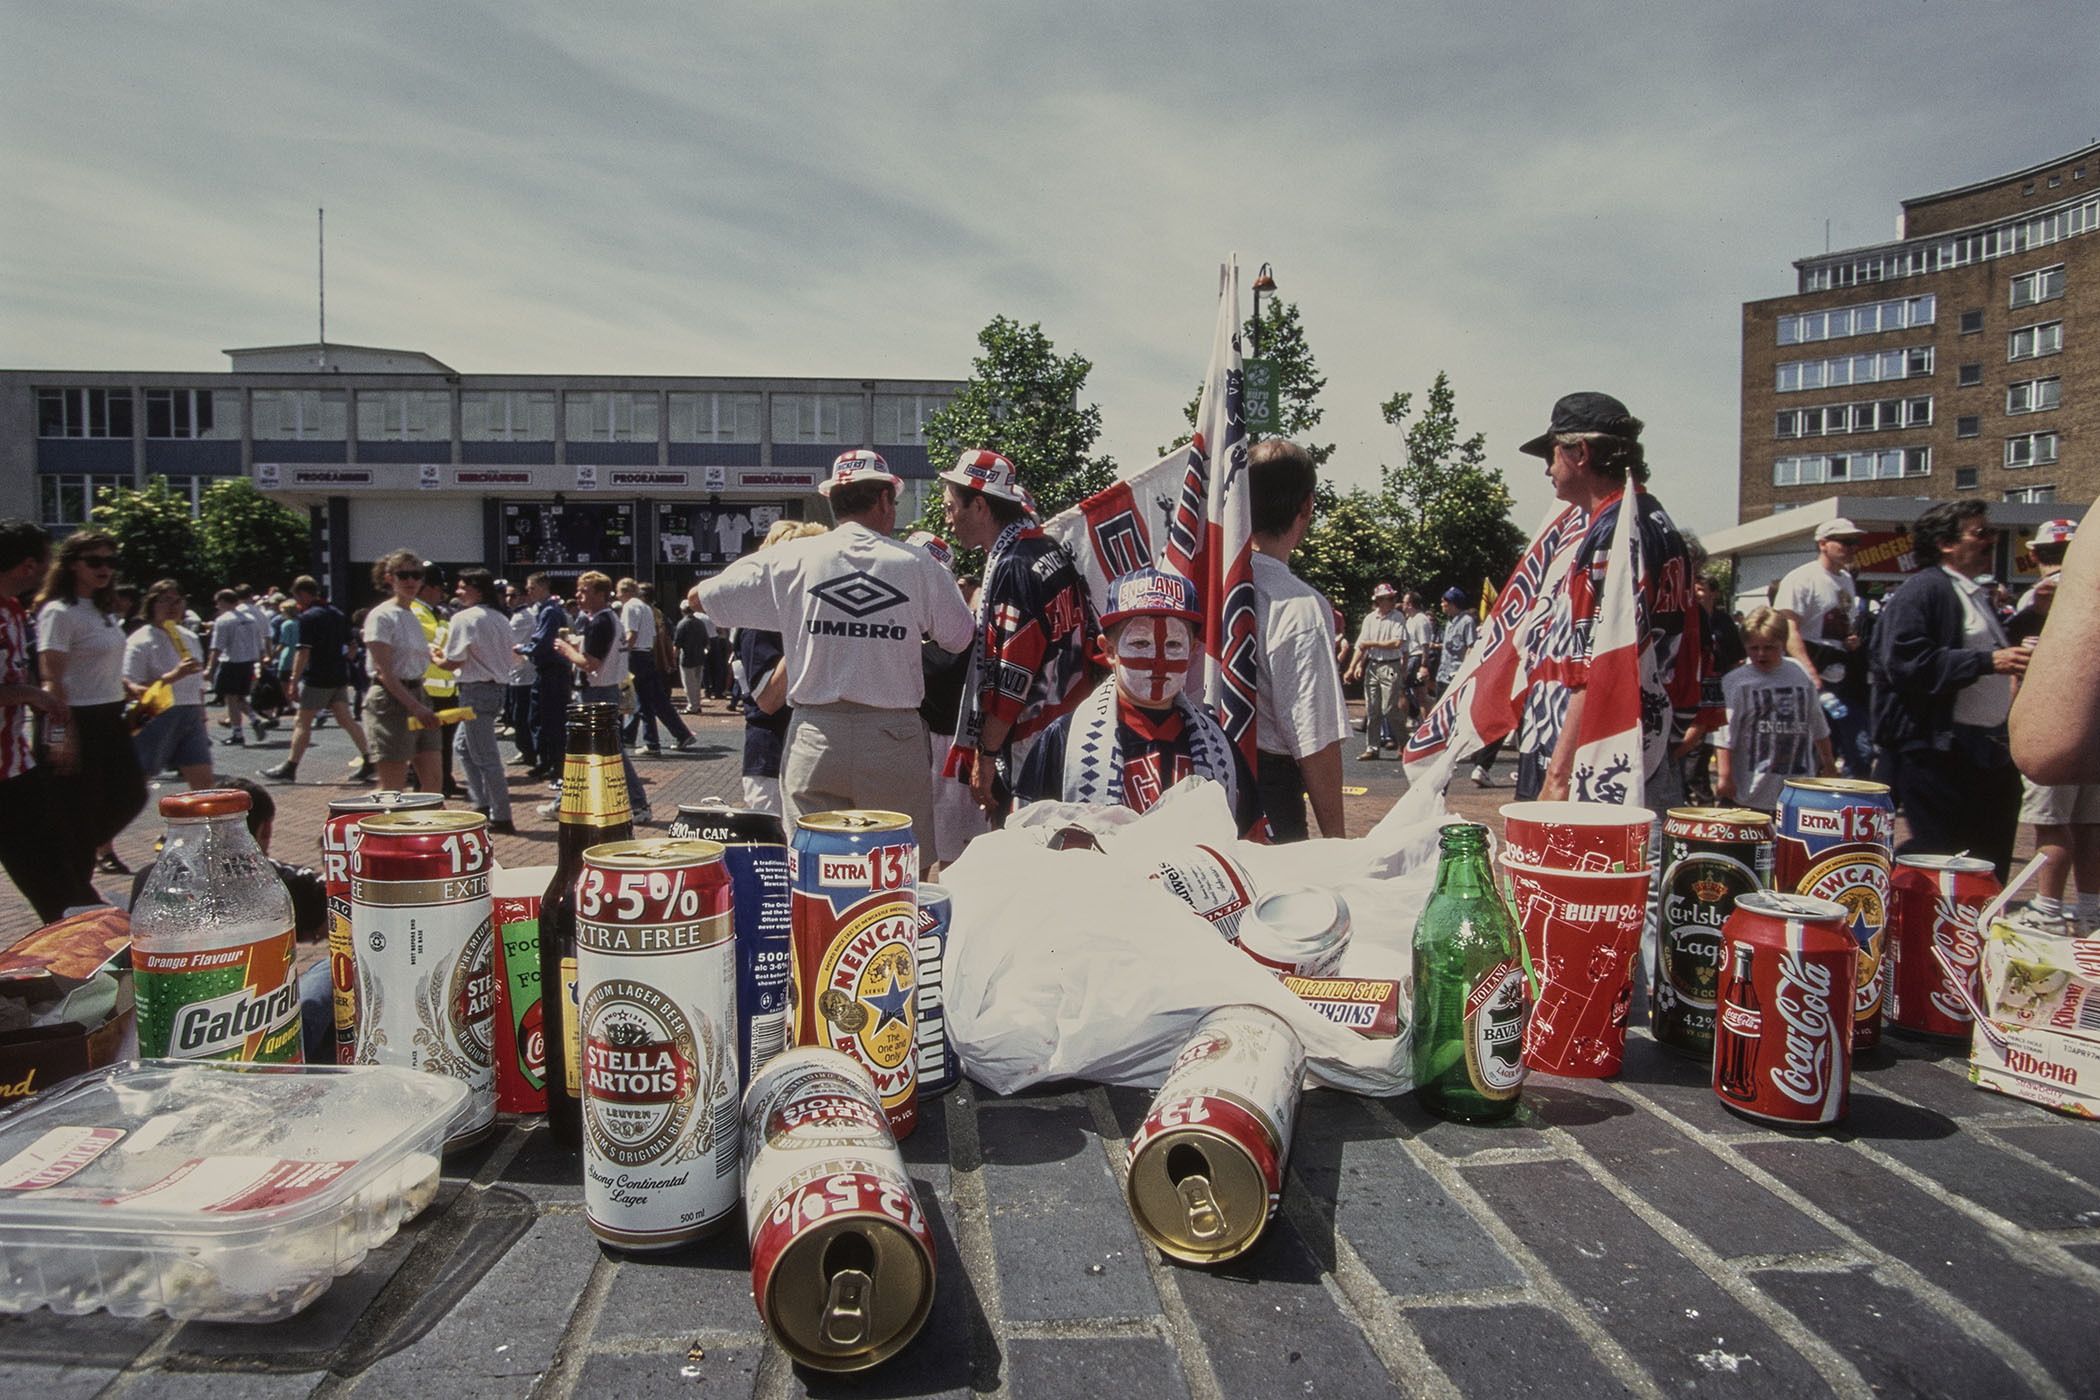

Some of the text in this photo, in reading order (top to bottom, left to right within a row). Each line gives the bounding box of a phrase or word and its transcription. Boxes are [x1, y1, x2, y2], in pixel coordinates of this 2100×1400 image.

[1247, 400, 1270, 418] 96
[1119, 576, 1184, 605] ENGLAND
[807, 620, 907, 640] UMBRO
[1664, 818, 1690, 836] Now
[1692, 823, 1735, 840] 4.2%
[1801, 814, 1839, 831] EXTRA
[703, 828, 729, 840] CAN
[824, 863, 867, 880] EXTRA
[444, 876, 488, 899] EXTR
[576, 924, 700, 949] EXTRA FREE
[148, 950, 244, 969] Orange Flavour
[1675, 934, 1720, 966] Lag
[1352, 981, 1392, 1002] CAPS
[1471, 963, 1508, 1006] HOLLAND
[179, 967, 299, 1050] Gatorad
[582, 984, 687, 1035] PREMIUM LAGER BEER
[2050, 983, 2085, 1029] Ribena
[1725, 1007, 1755, 1028] Coca-Cola
[886, 1032, 900, 1043] The
[1770, 953, 1832, 1105] Coca-Cola
[587, 1045, 676, 1071] STELLA
[878, 1041, 907, 1054] One and
[884, 1051, 901, 1063] Only
[1496, 1066, 1516, 1078] LAGER
[2004, 1047, 2078, 1086] Ribena
[588, 1070, 677, 1094] ARTOIS
[2016, 1078, 2064, 1098] Strawberry
[2019, 1089, 2056, 1104] Juice Drink
[606, 1107, 651, 1120] LEUVEN
[783, 1098, 877, 1117] ARTOIS
[783, 1106, 879, 1130] STELLA
[618, 1135, 673, 1163] ORIGINAL
[669, 1105, 690, 1136] BEER
[587, 1165, 690, 1190] Strong Continental
[770, 1163, 829, 1209] FREE
[609, 1189, 649, 1207] Lager
[680, 1208, 706, 1224] 500 ml
